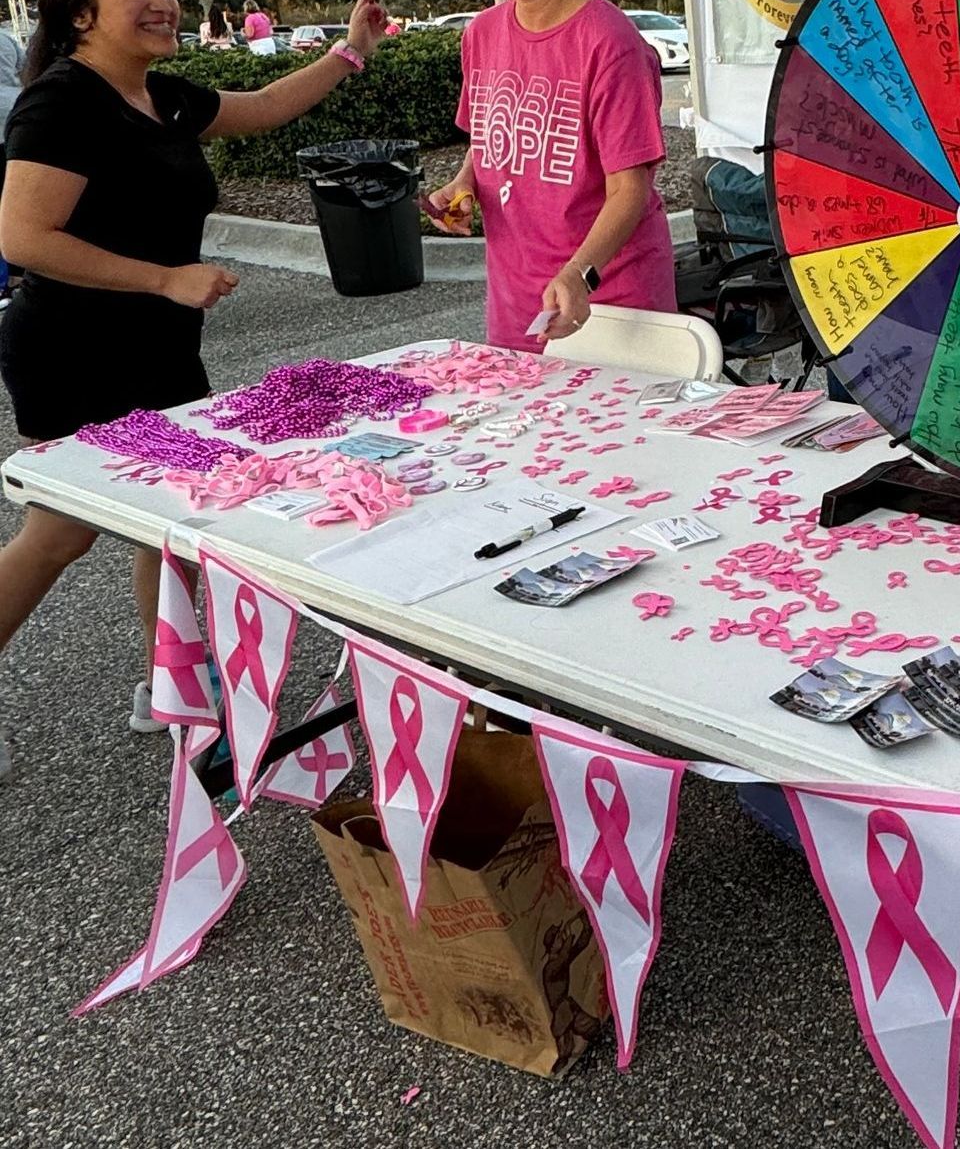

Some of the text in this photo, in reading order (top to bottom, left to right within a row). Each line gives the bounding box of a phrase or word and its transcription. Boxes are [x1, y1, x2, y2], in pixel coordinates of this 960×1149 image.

[803, 267, 843, 342] How many
[829, 270, 856, 328] teeth
[845, 273, 868, 311] does
[933, 365, 956, 406] many
